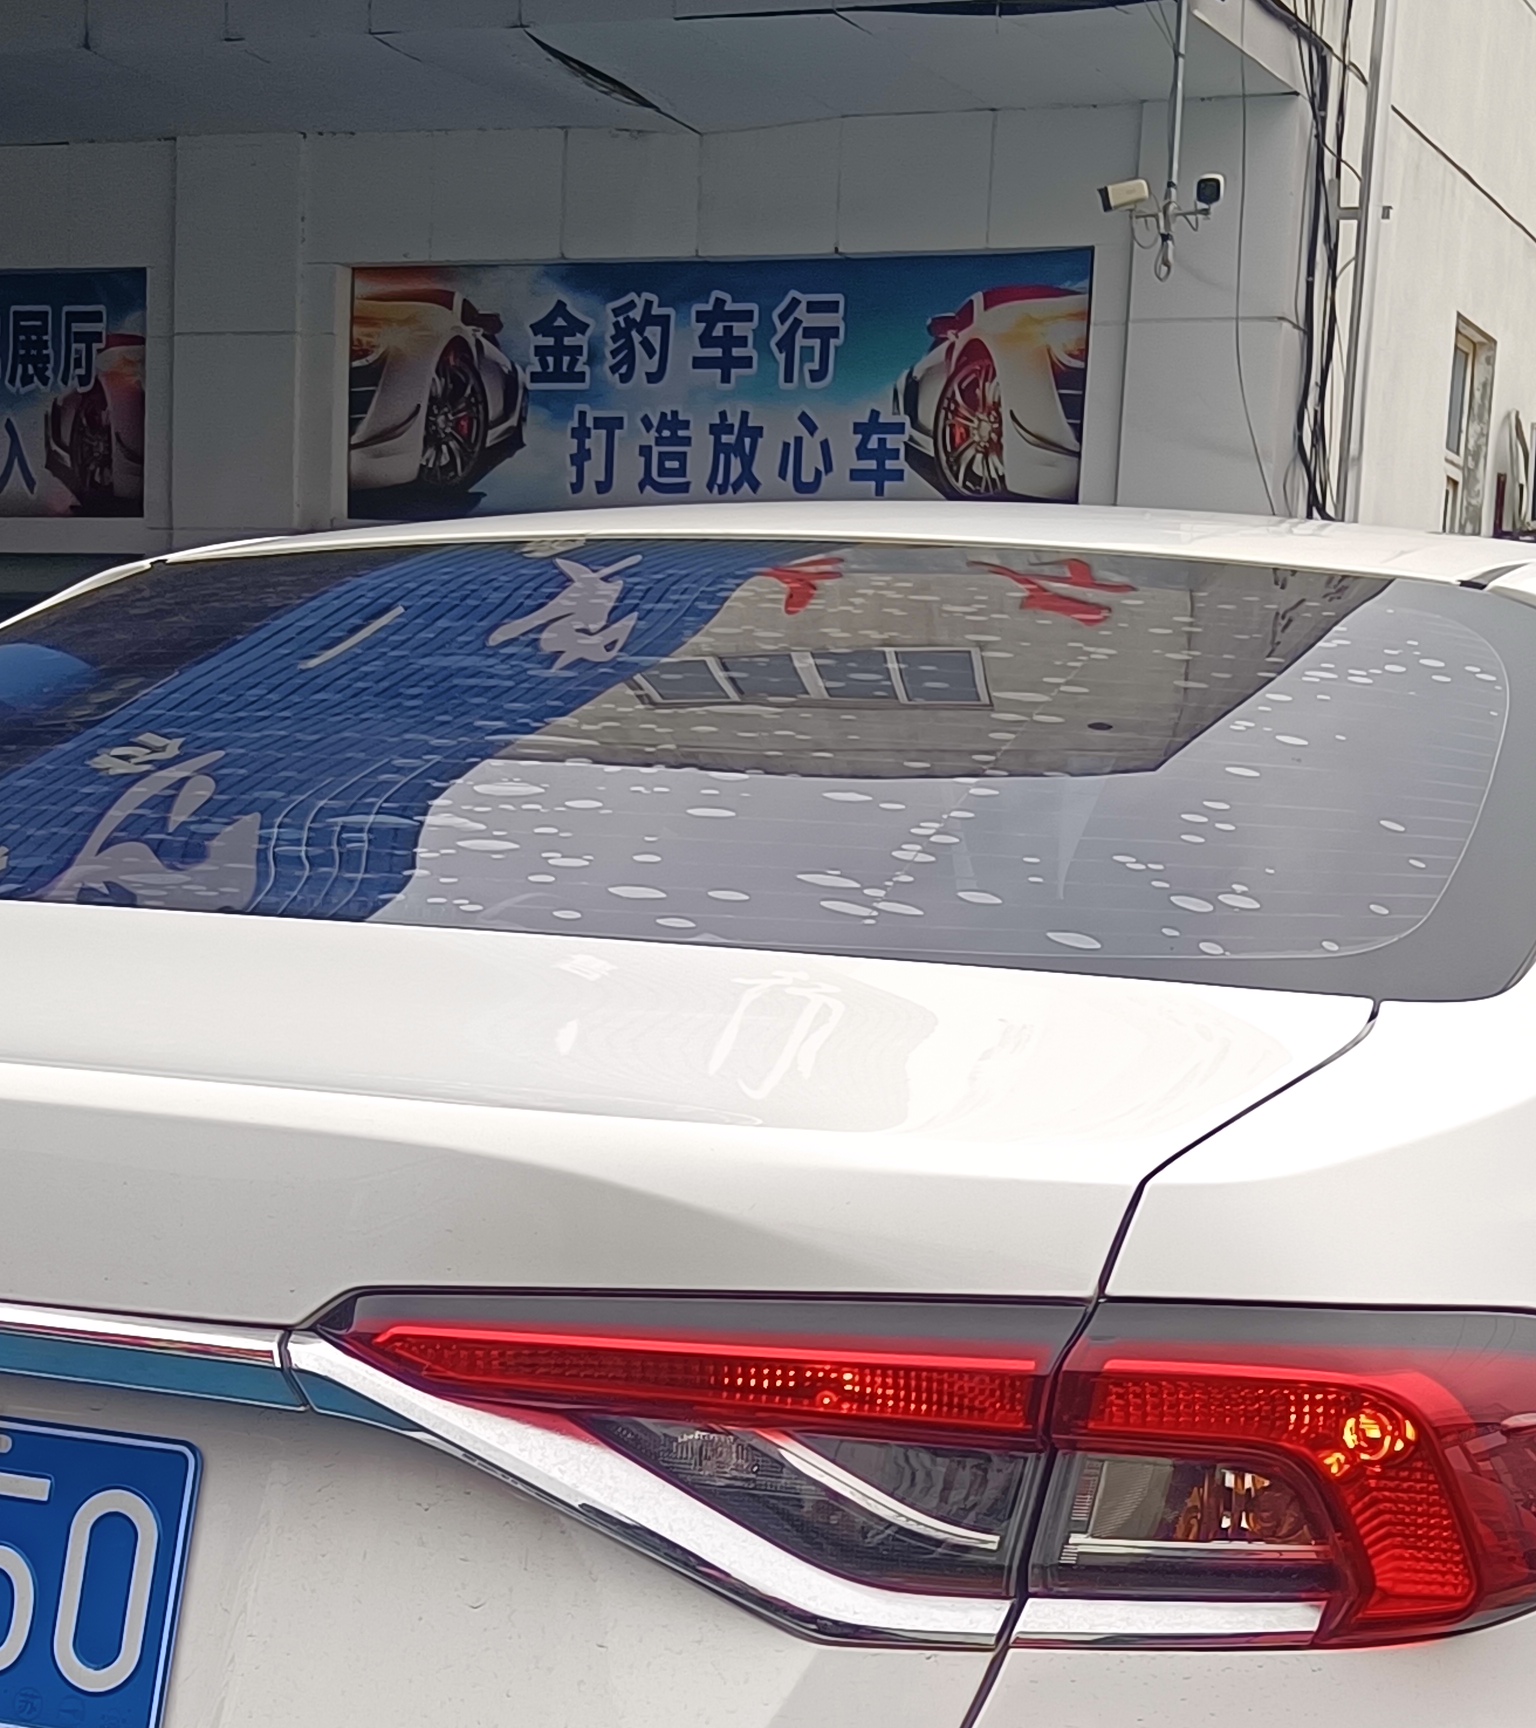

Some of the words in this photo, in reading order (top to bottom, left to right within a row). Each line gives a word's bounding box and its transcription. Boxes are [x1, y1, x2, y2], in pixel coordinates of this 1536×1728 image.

[526, 290, 846, 390] 金豹车行
[568, 407, 911, 497] 打造放心车
